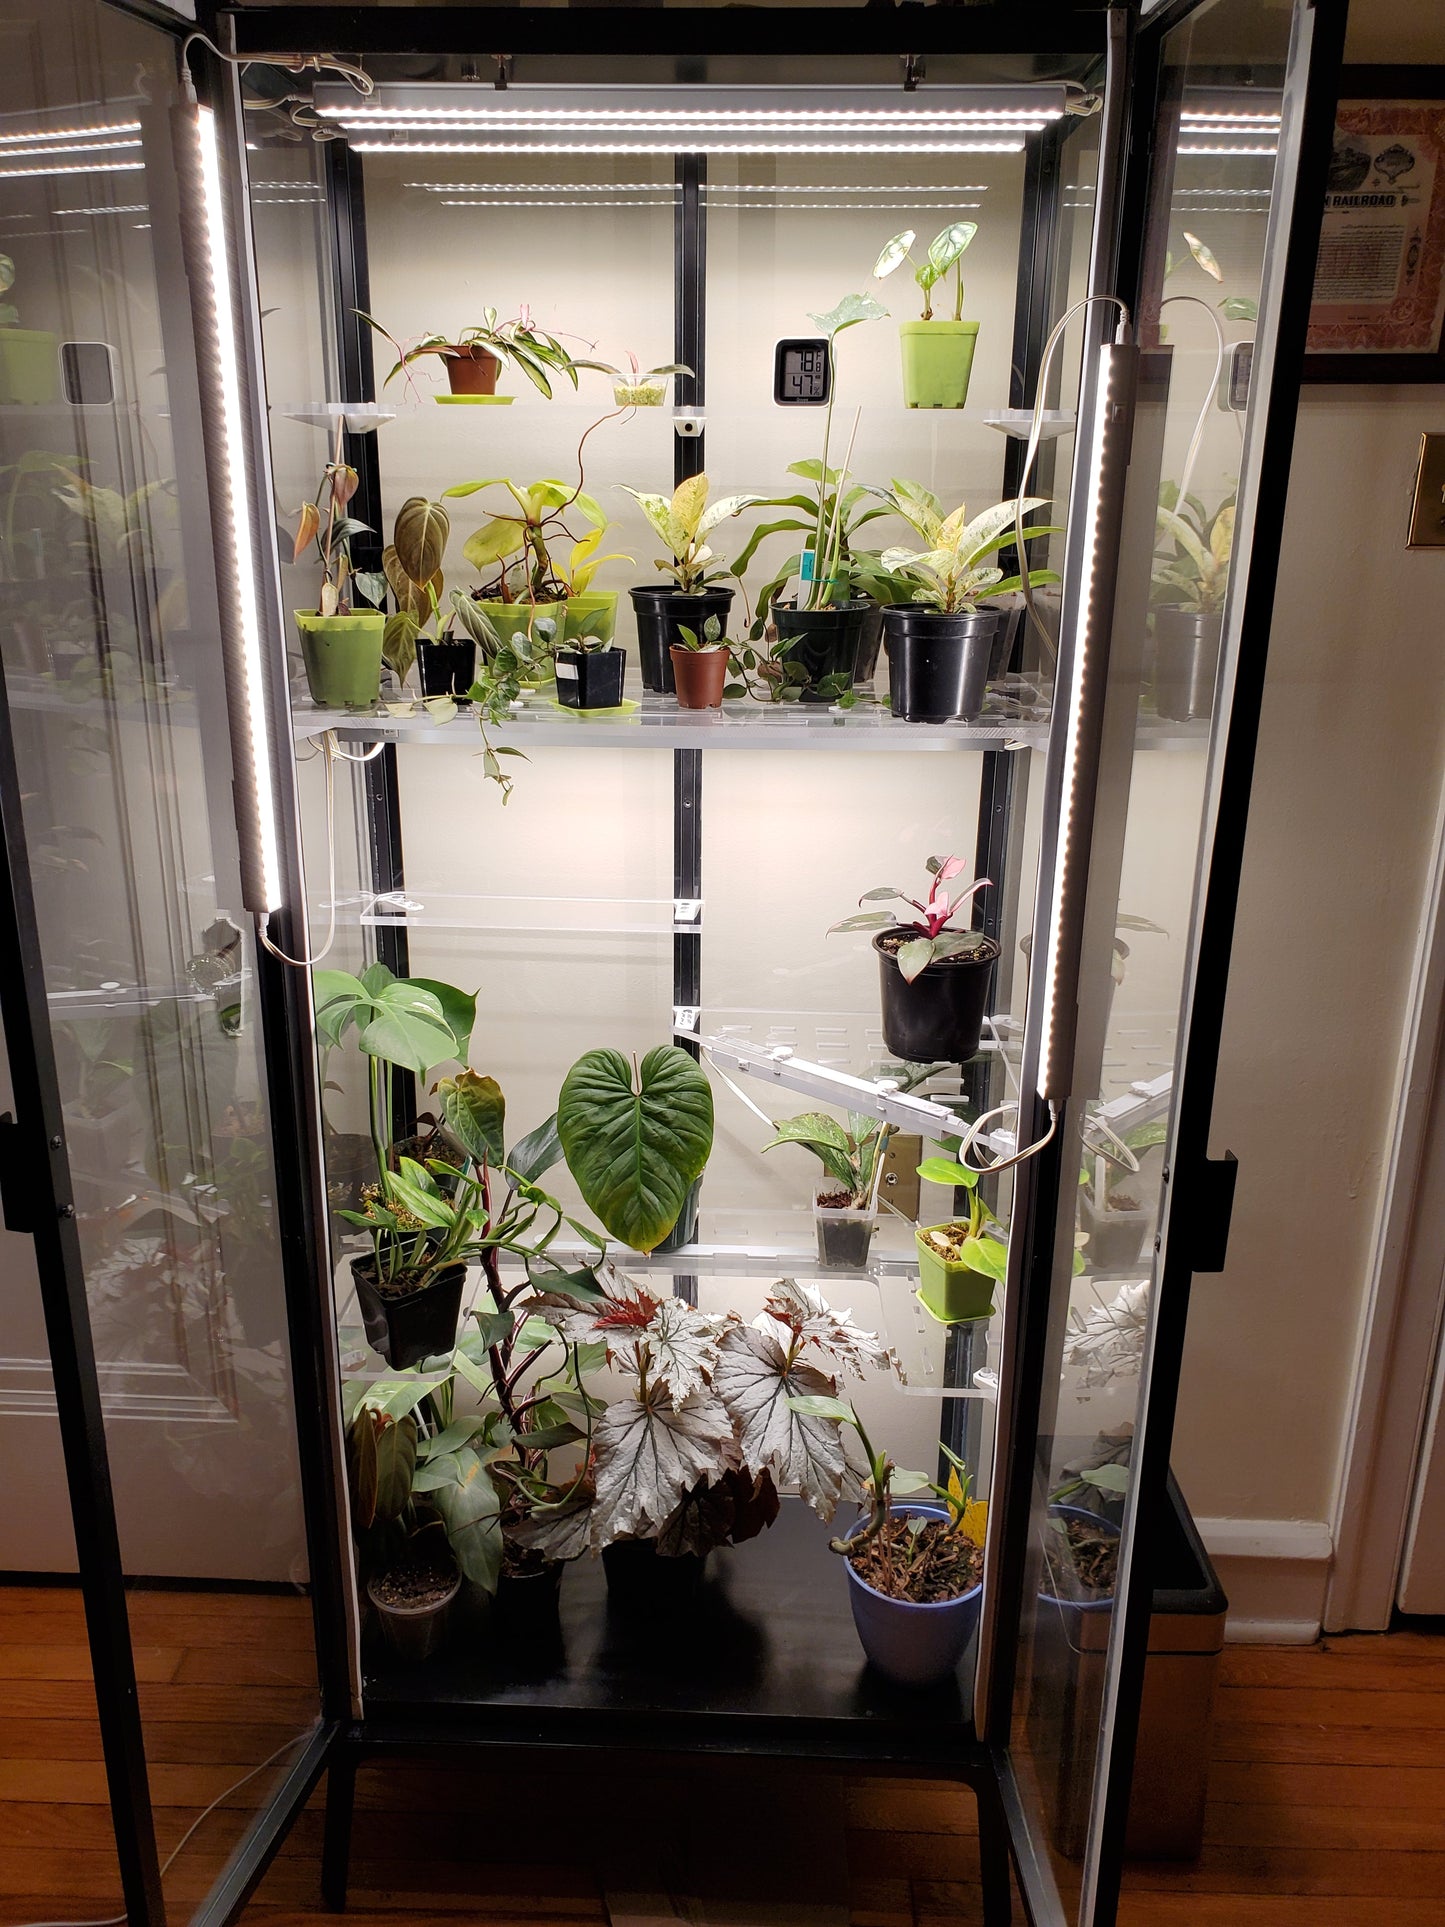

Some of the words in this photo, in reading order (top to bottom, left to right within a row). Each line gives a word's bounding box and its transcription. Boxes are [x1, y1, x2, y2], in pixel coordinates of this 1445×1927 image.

[1333, 195, 1395, 206] RAILROAD
[795, 351, 813, 372] 78
[792, 375, 813, 395] 47
